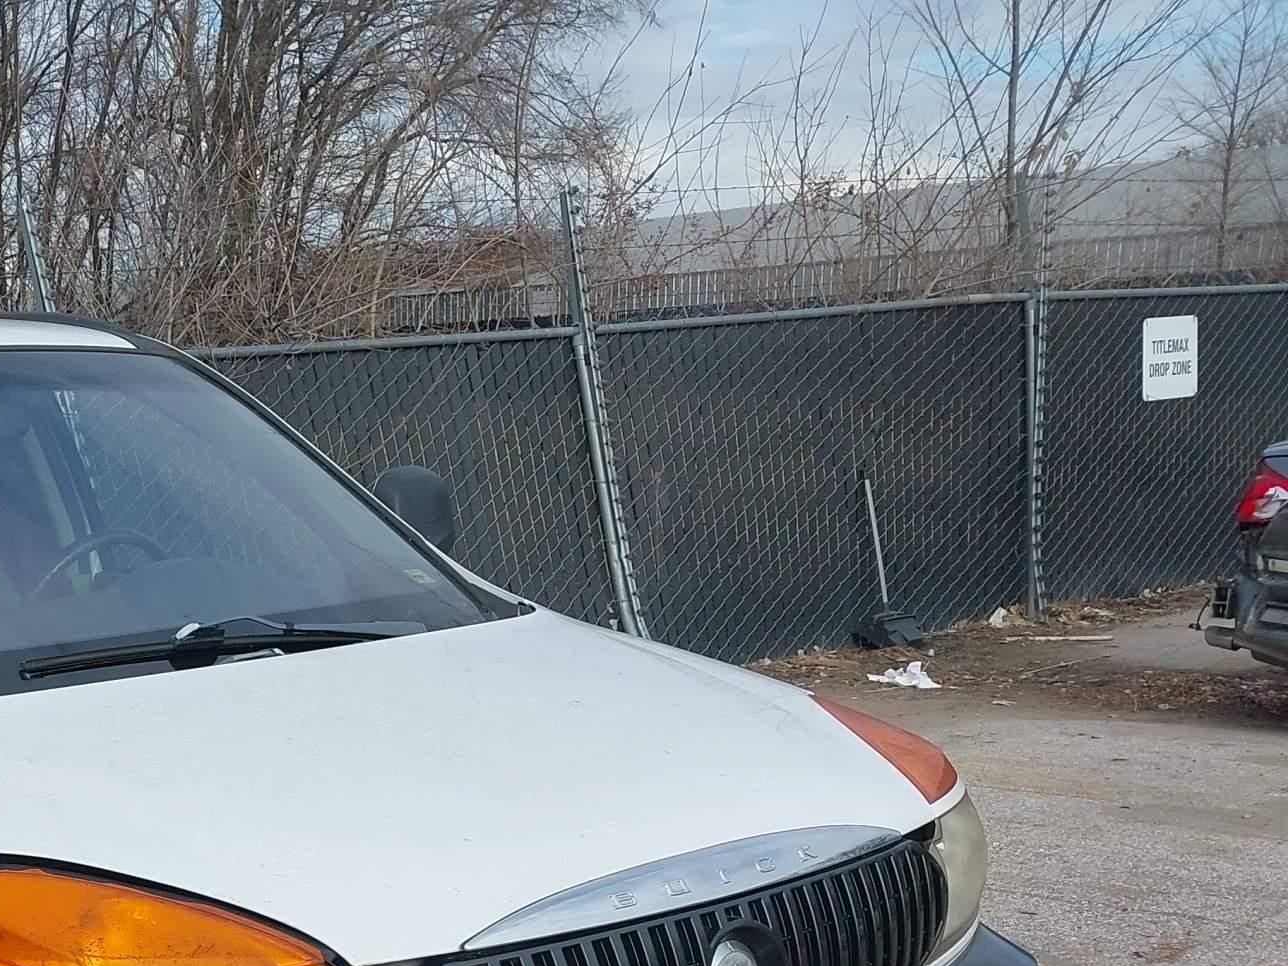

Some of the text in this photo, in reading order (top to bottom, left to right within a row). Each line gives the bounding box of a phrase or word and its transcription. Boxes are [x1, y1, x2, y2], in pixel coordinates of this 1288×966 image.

[1151, 338, 1190, 355] TITLEMAX
[1149, 360, 1192, 378] DROP ZONE
[608, 843, 818, 911] BUICK
